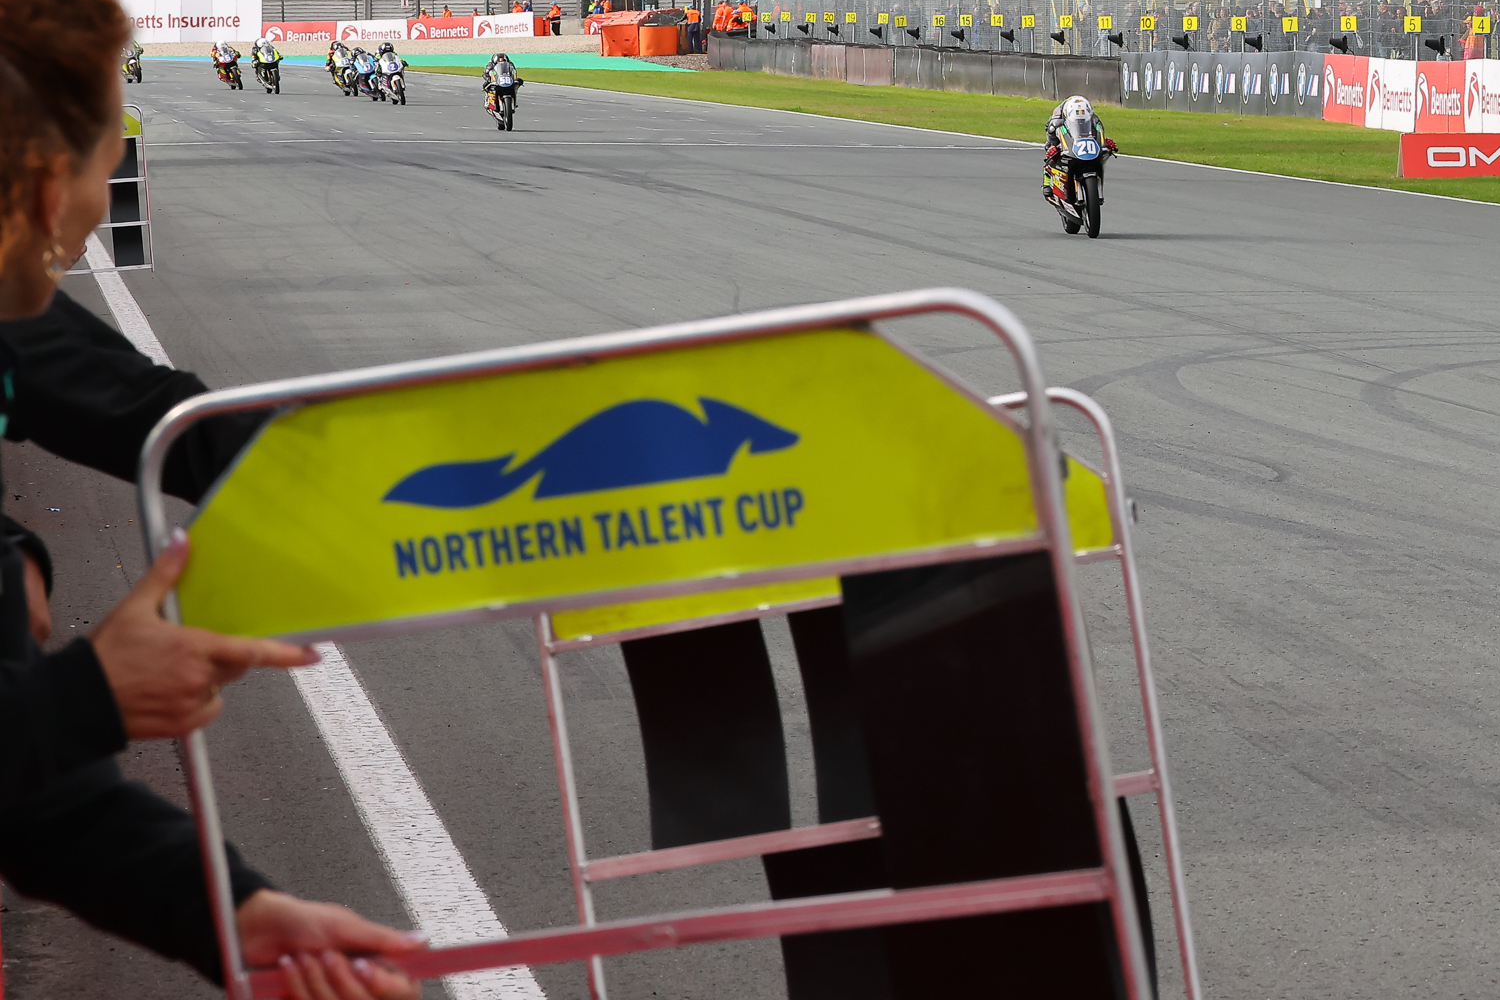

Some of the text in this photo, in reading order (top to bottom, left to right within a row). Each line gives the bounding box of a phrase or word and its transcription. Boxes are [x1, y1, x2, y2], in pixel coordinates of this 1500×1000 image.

[168, 13, 241, 28] Insurance
[807, 13, 815, 21] 21
[825, 13, 833, 21] 20
[848, 13, 855, 21] 19
[896, 17, 904, 25] 17
[934, 16, 943, 25] 16
[962, 15, 970, 25] 15
[992, 15, 1001, 25] 14
[1023, 16, 1032, 25] 13
[1061, 16, 1071, 26] 12
[1100, 17, 1108, 27] 11
[1141, 17, 1151, 28] 10
[495, 22, 529, 35] Bennetts
[1186, 18, 1192, 28] 9
[1235, 18, 1242, 29] 8
[1287, 18, 1293, 30] 7
[1345, 18, 1352, 29] 6
[1409, 18, 1416, 31] 5
[1477, 18, 1485, 30] 4
[286, 30, 331, 42] Bennetts
[361, 29, 402, 40] Bennetts
[430, 25, 469, 38] Bennetts
[1336, 78, 1364, 108] Bennetts
[1383, 83, 1412, 113] Bennetts
[1431, 85, 1461, 116] Bennetts
[1076, 140, 1096, 156] 20
[393, 487, 805, 579] NORTHERN TALENT CUP
